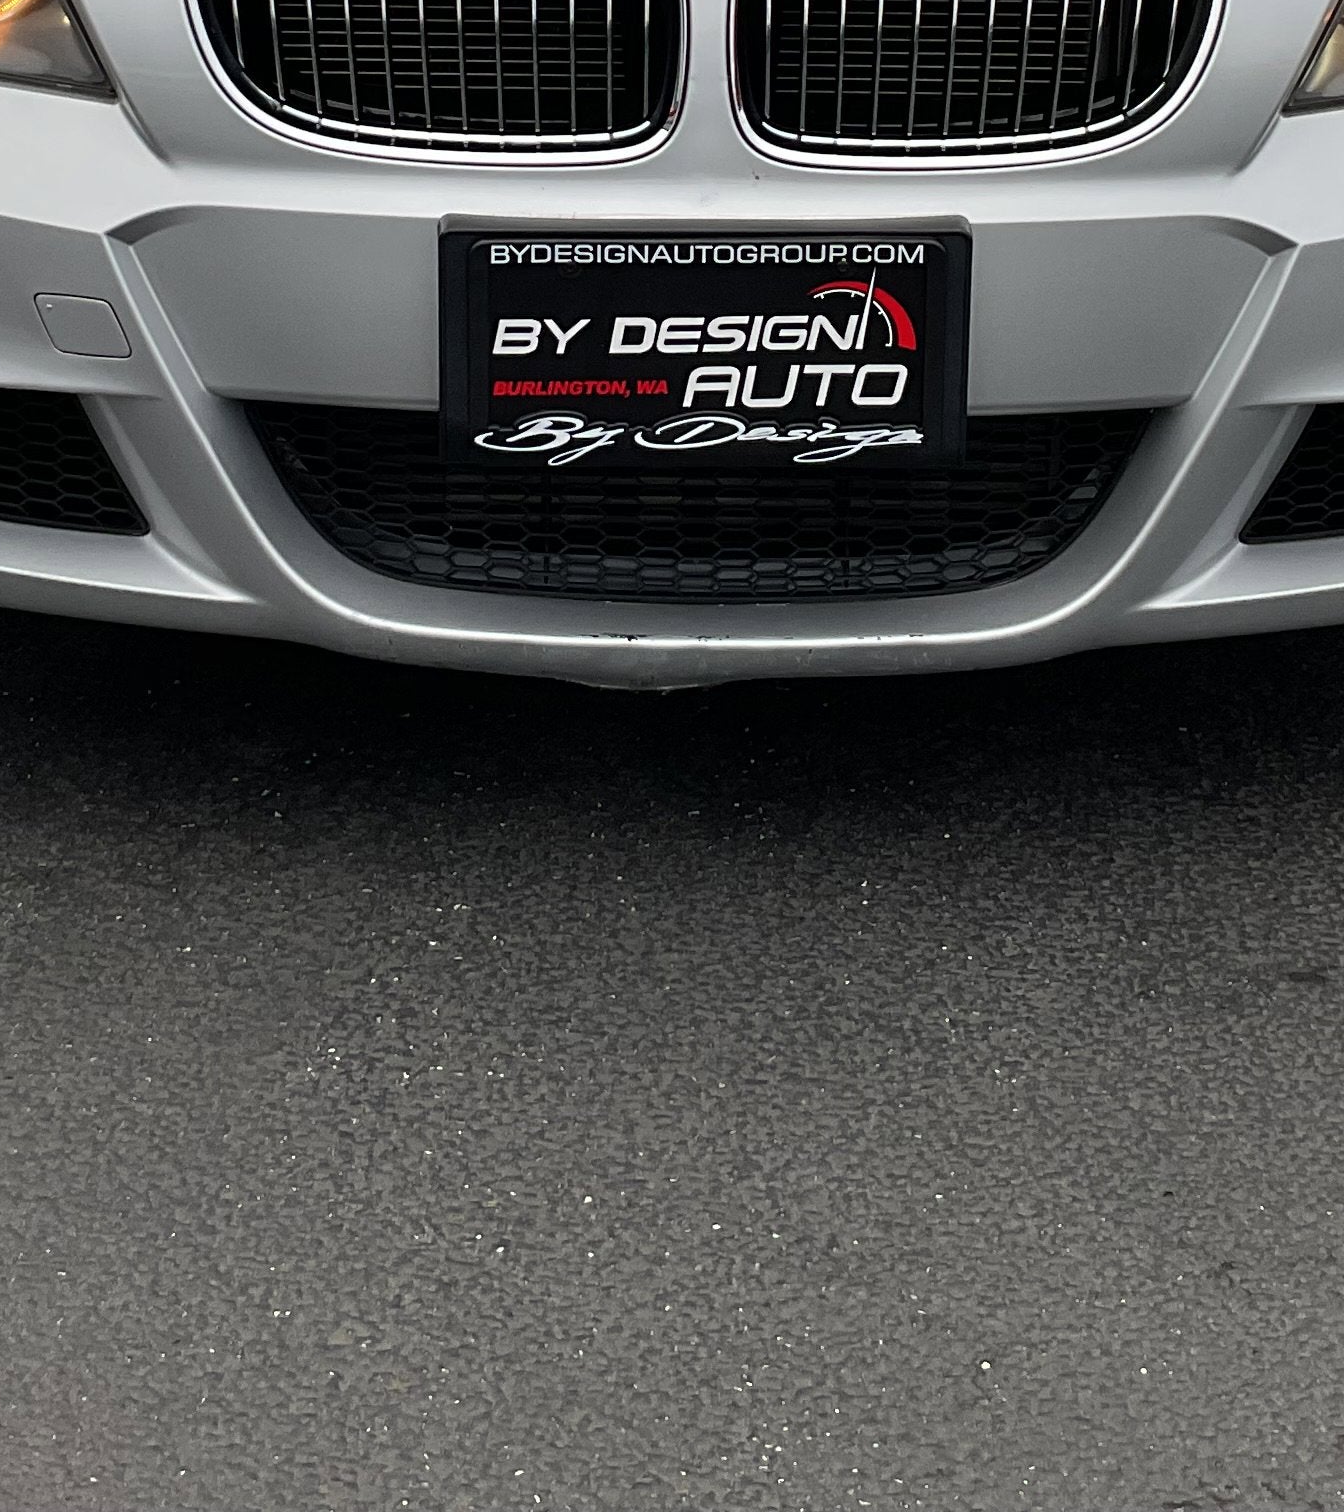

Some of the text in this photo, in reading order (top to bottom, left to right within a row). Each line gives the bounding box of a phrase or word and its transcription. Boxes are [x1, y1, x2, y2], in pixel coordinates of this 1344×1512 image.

[490, 244, 925, 265] BYDESIGNAUTOGROUP.COM
[492, 314, 860, 355] BY DESIGN
[493, 379, 669, 399] BURLINGTON, WA
[682, 364, 909, 408] AUTO
[474, 415, 924, 466] By Design
